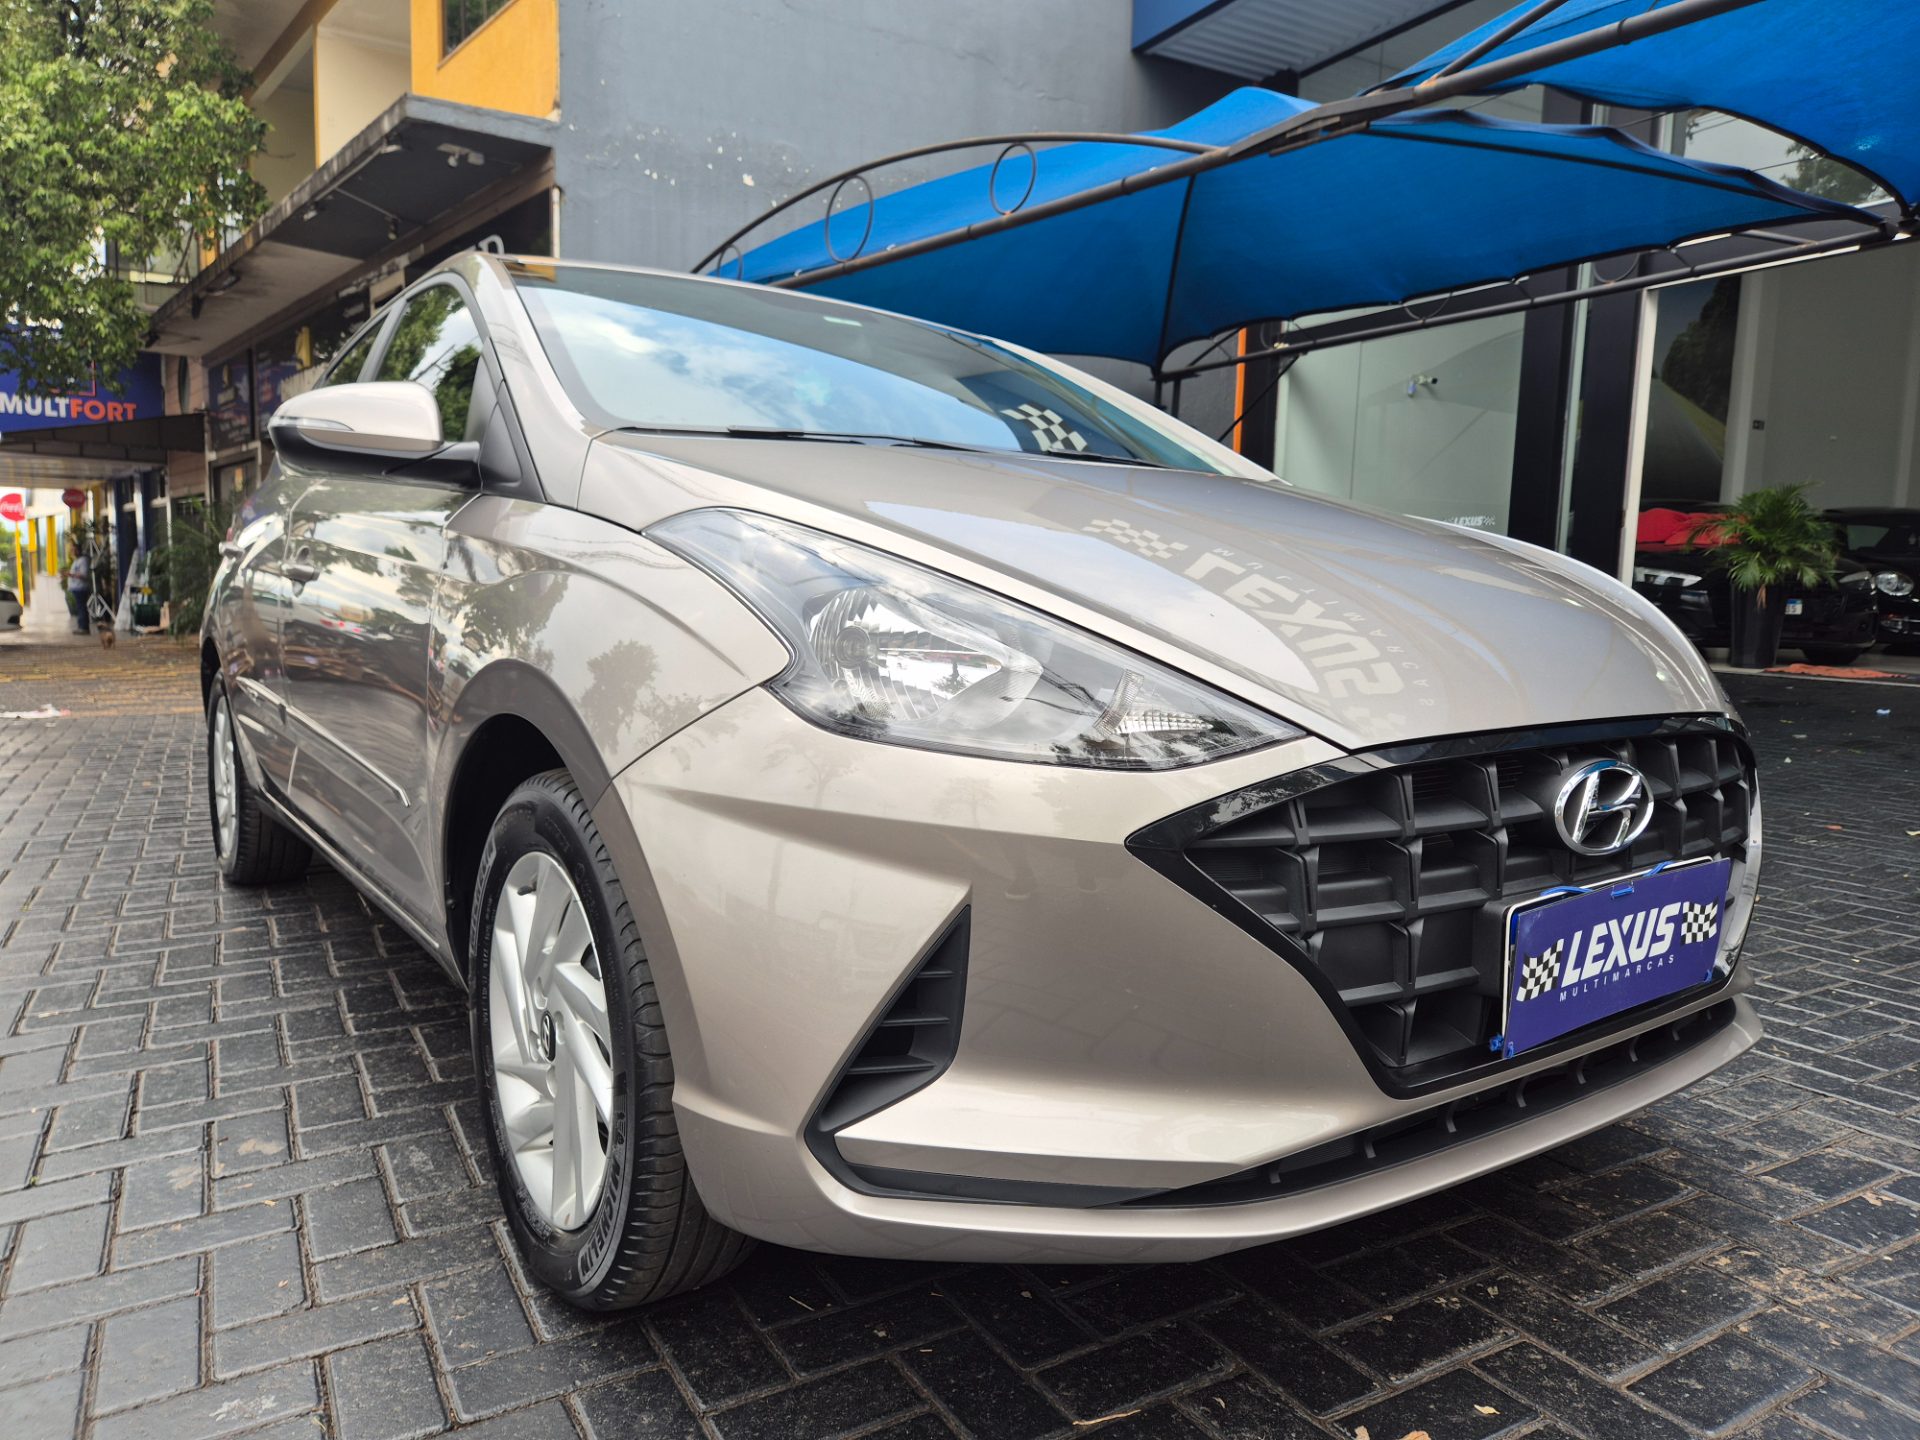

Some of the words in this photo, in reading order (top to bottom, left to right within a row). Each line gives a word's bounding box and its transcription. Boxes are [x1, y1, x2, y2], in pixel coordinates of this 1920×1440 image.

[0, 392, 136, 421] MULTFORT
[1559, 954, 1675, 1002] MULTIMARCAS
[1561, 902, 1682, 988] LEXUS
[579, 1155, 622, 1278] MICHELIN
